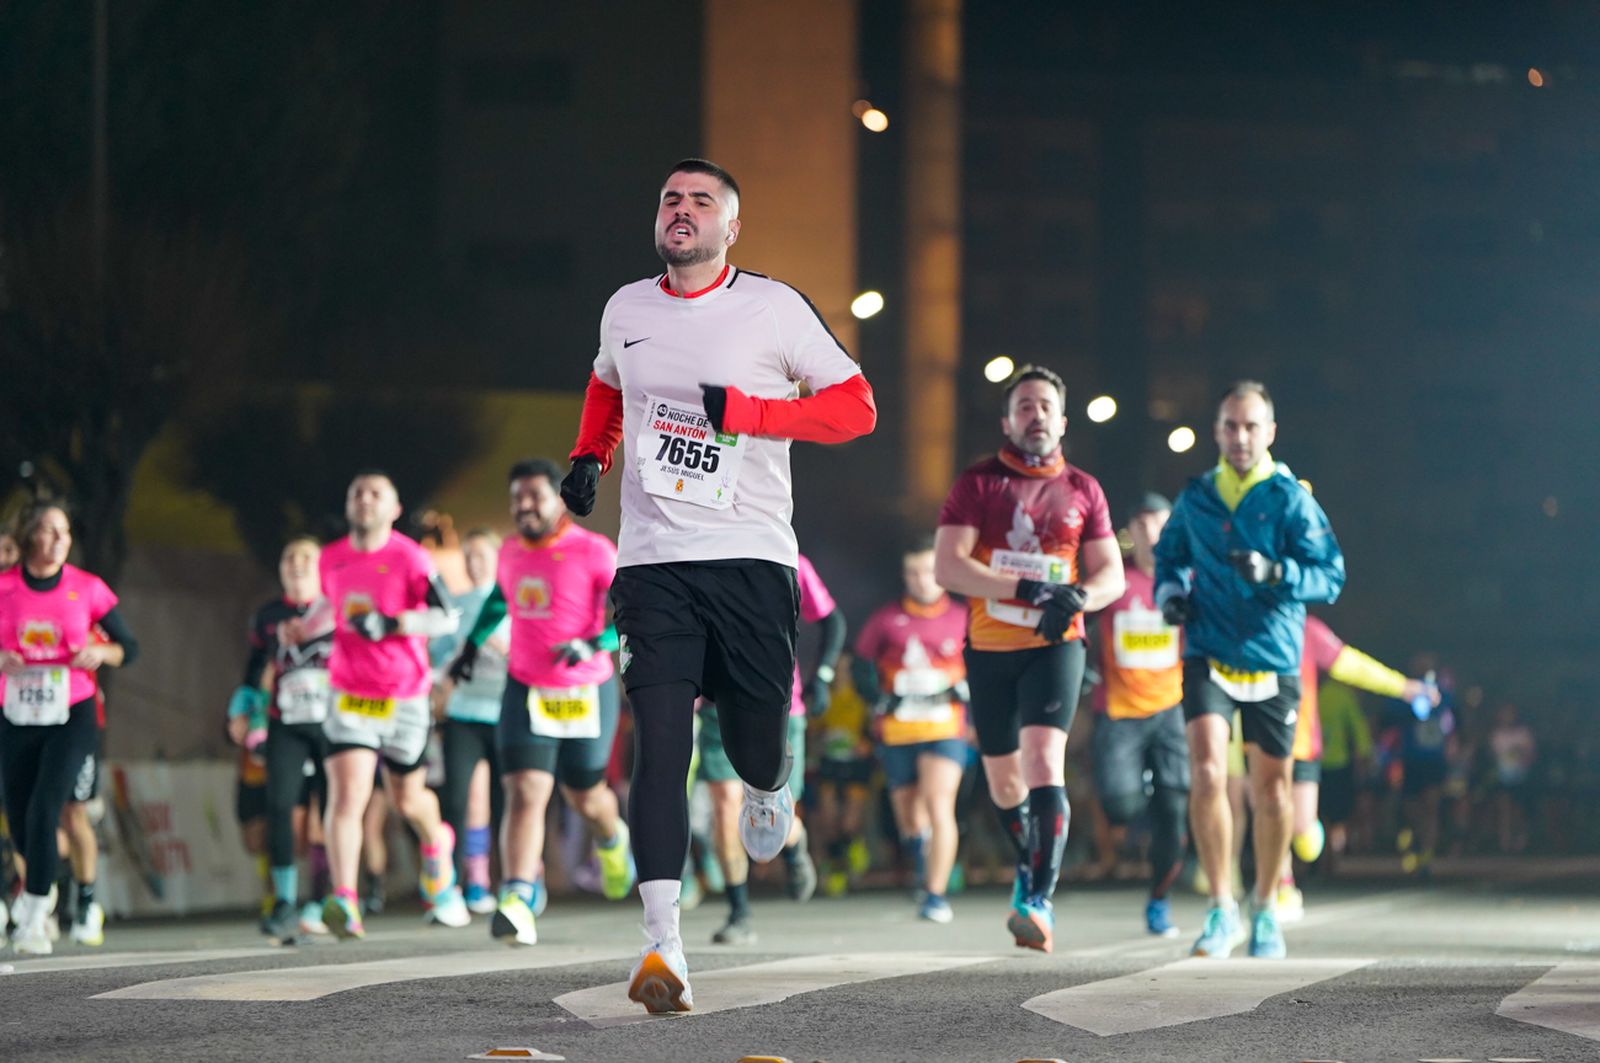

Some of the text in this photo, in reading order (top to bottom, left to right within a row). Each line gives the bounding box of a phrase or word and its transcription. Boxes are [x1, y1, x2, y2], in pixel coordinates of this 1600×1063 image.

[667, 411, 696, 425] NOCHE
[696, 417, 709, 428] DE
[653, 420, 673, 433] SAN
[673, 425, 708, 440] ANTÓN
[655, 434, 721, 473] 7655
[680, 469, 705, 481] MIGUEL
